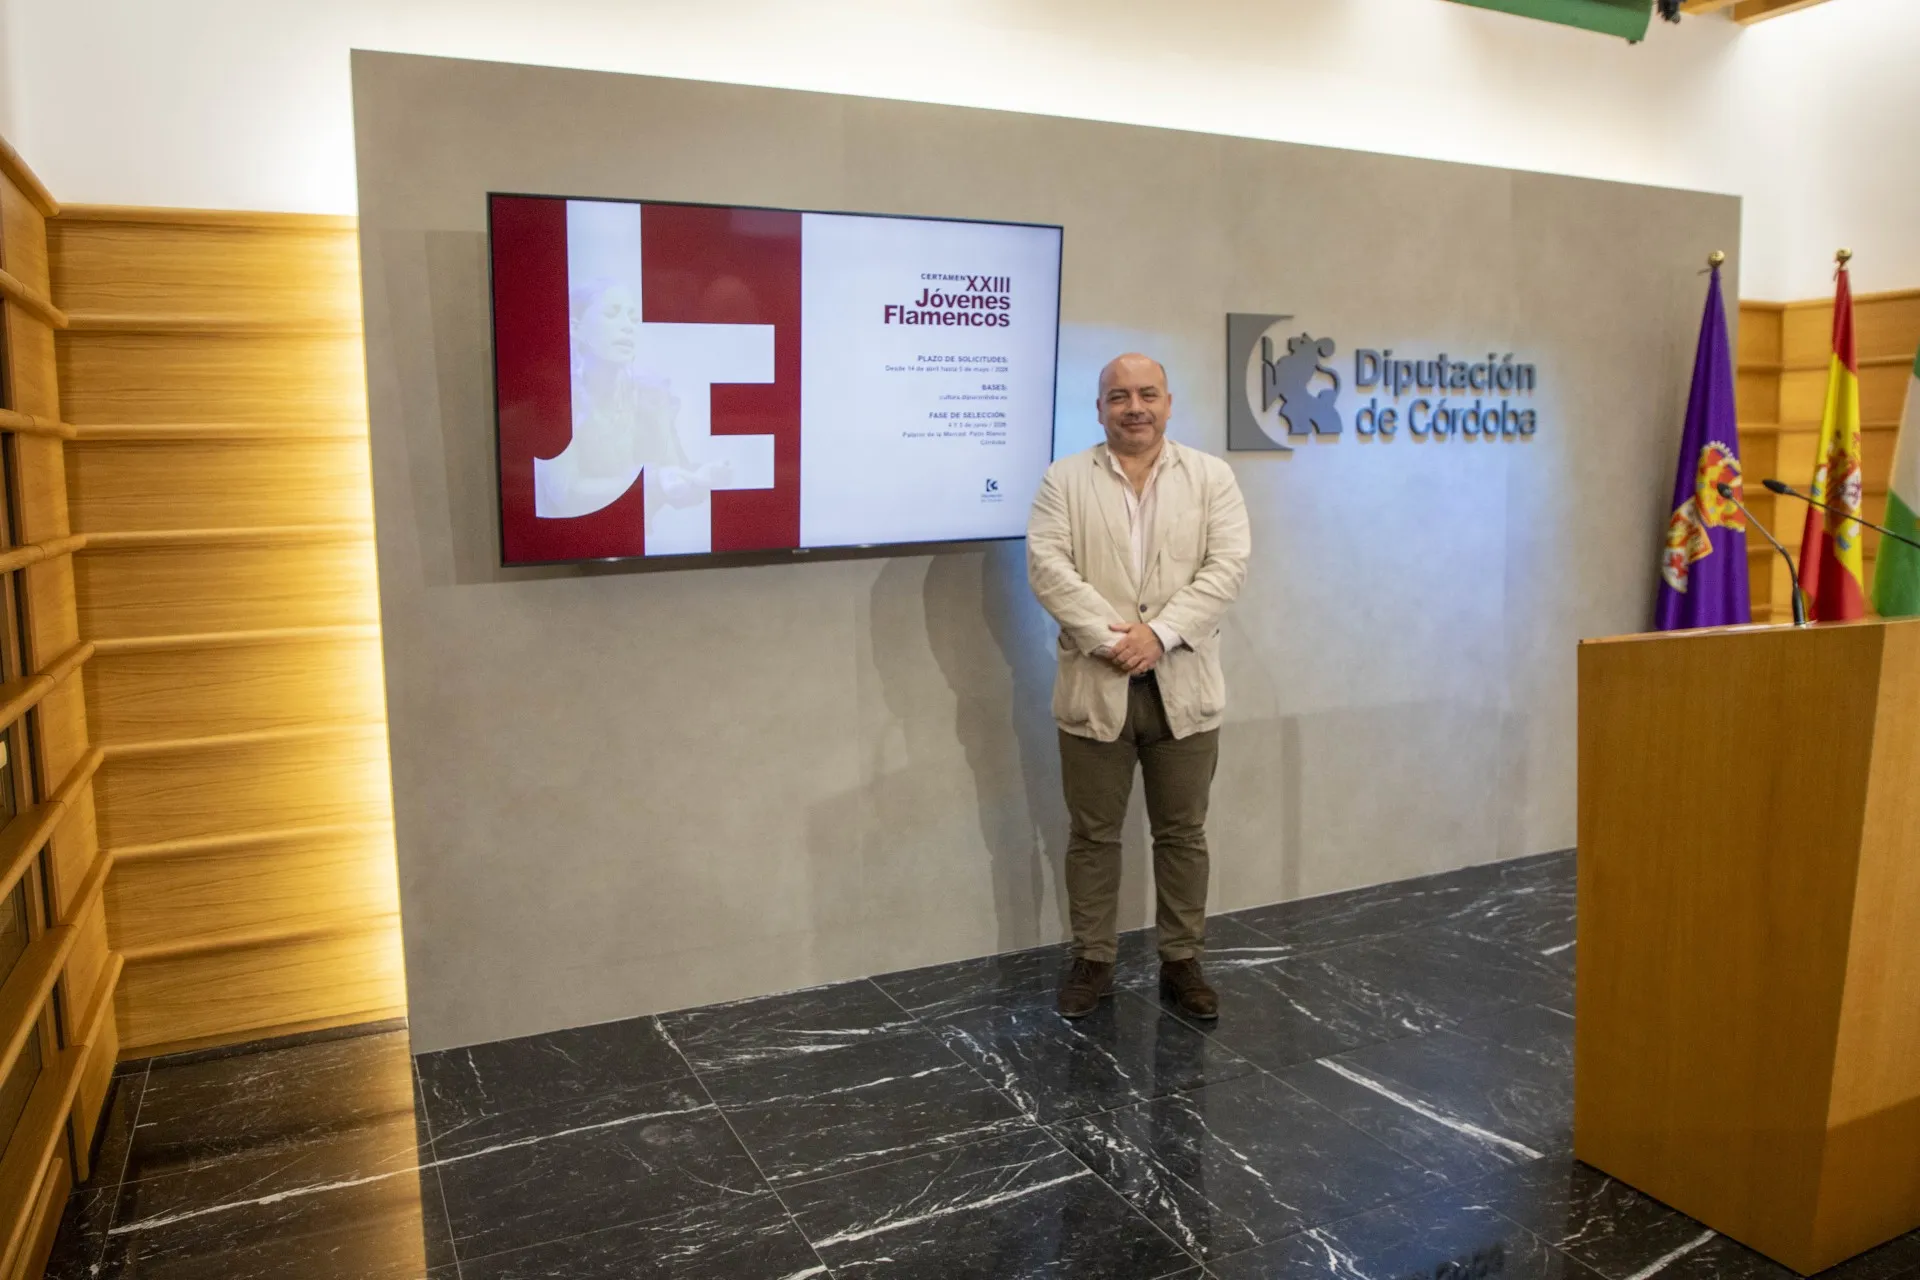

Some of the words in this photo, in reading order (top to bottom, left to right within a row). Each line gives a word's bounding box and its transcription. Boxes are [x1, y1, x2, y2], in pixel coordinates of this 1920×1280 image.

[921, 273, 966, 281] CERTAMEN
[965, 275, 1010, 293] XXIII
[915, 288, 1011, 310] Jóvenes
[884, 304, 1010, 327] Flamencos
[918, 355, 943, 363] PLAZO
[945, 355, 955, 363] DE
[1355, 348, 1536, 397] Diputación
[1356, 398, 1398, 435] de
[1409, 397, 1536, 435] Córdoba
